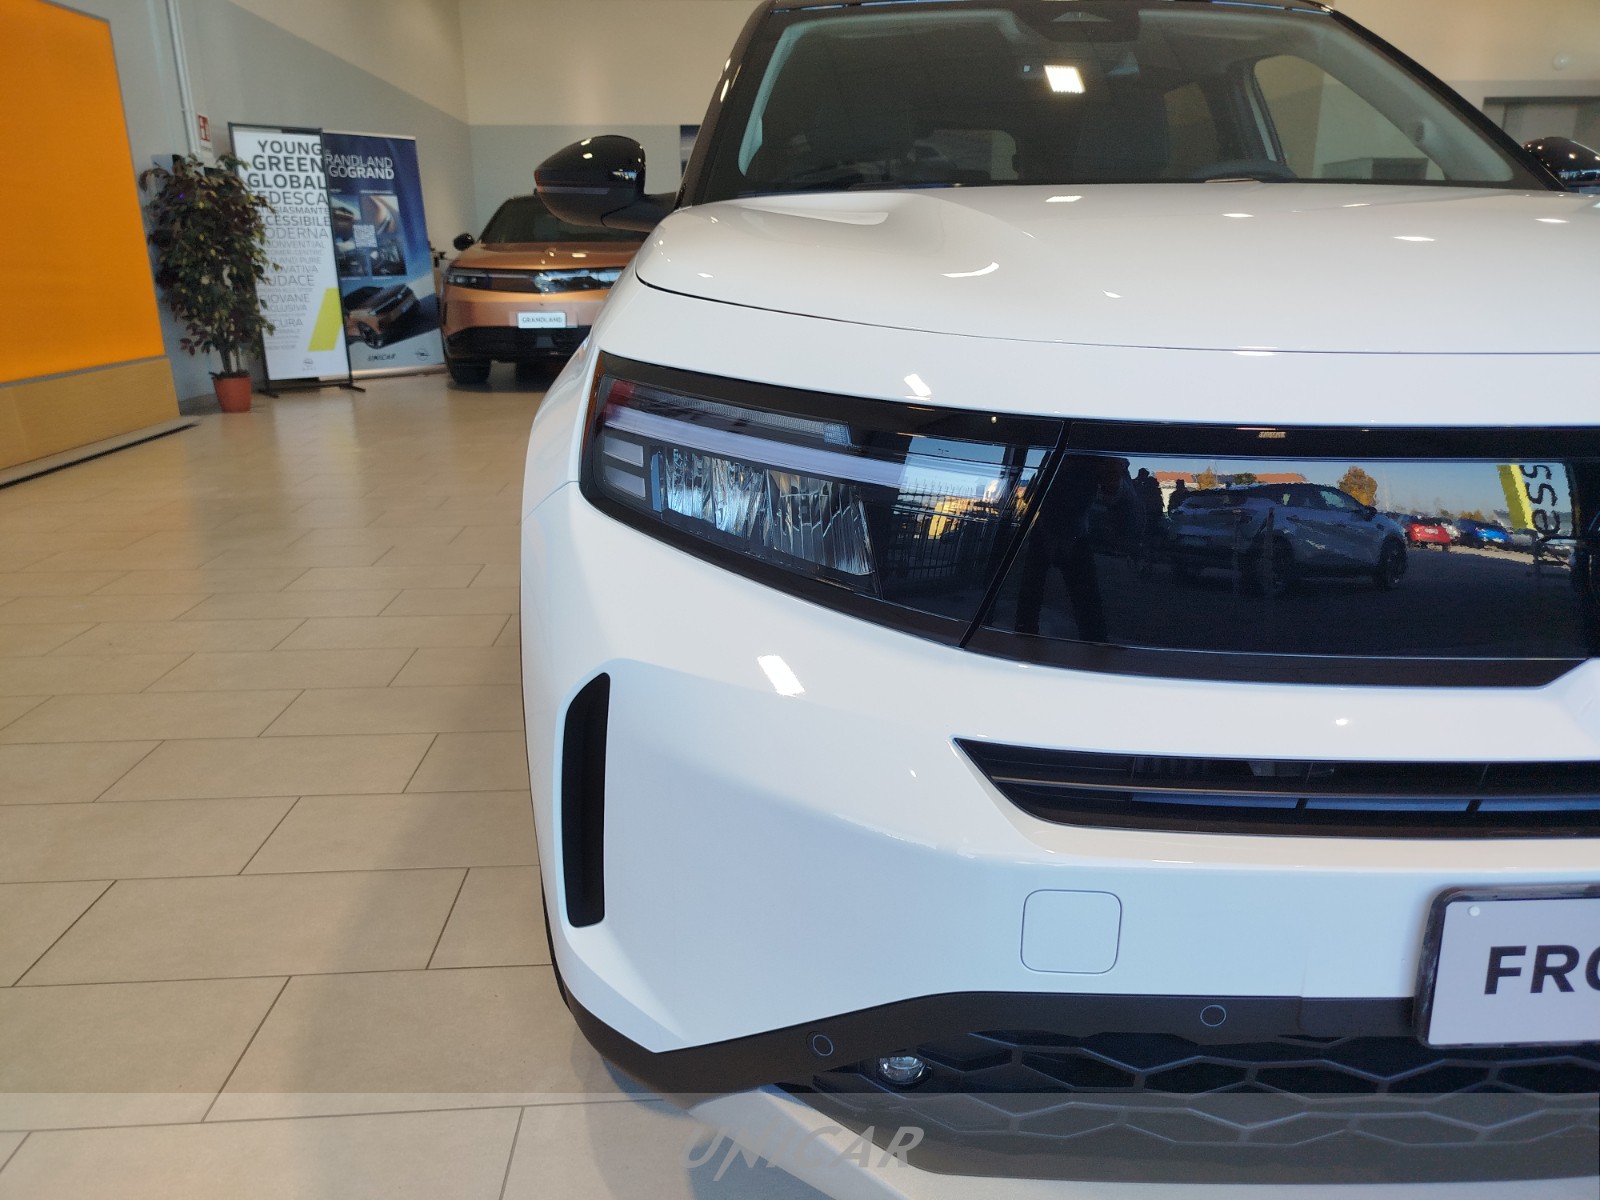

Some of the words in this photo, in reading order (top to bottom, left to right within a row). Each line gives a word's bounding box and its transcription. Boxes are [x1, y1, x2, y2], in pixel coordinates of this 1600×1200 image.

[257, 140, 323, 157] YOUNG
[252, 154, 324, 174] GREEN
[325, 153, 394, 169] RANDLAND
[247, 172, 328, 190] GLOBAL
